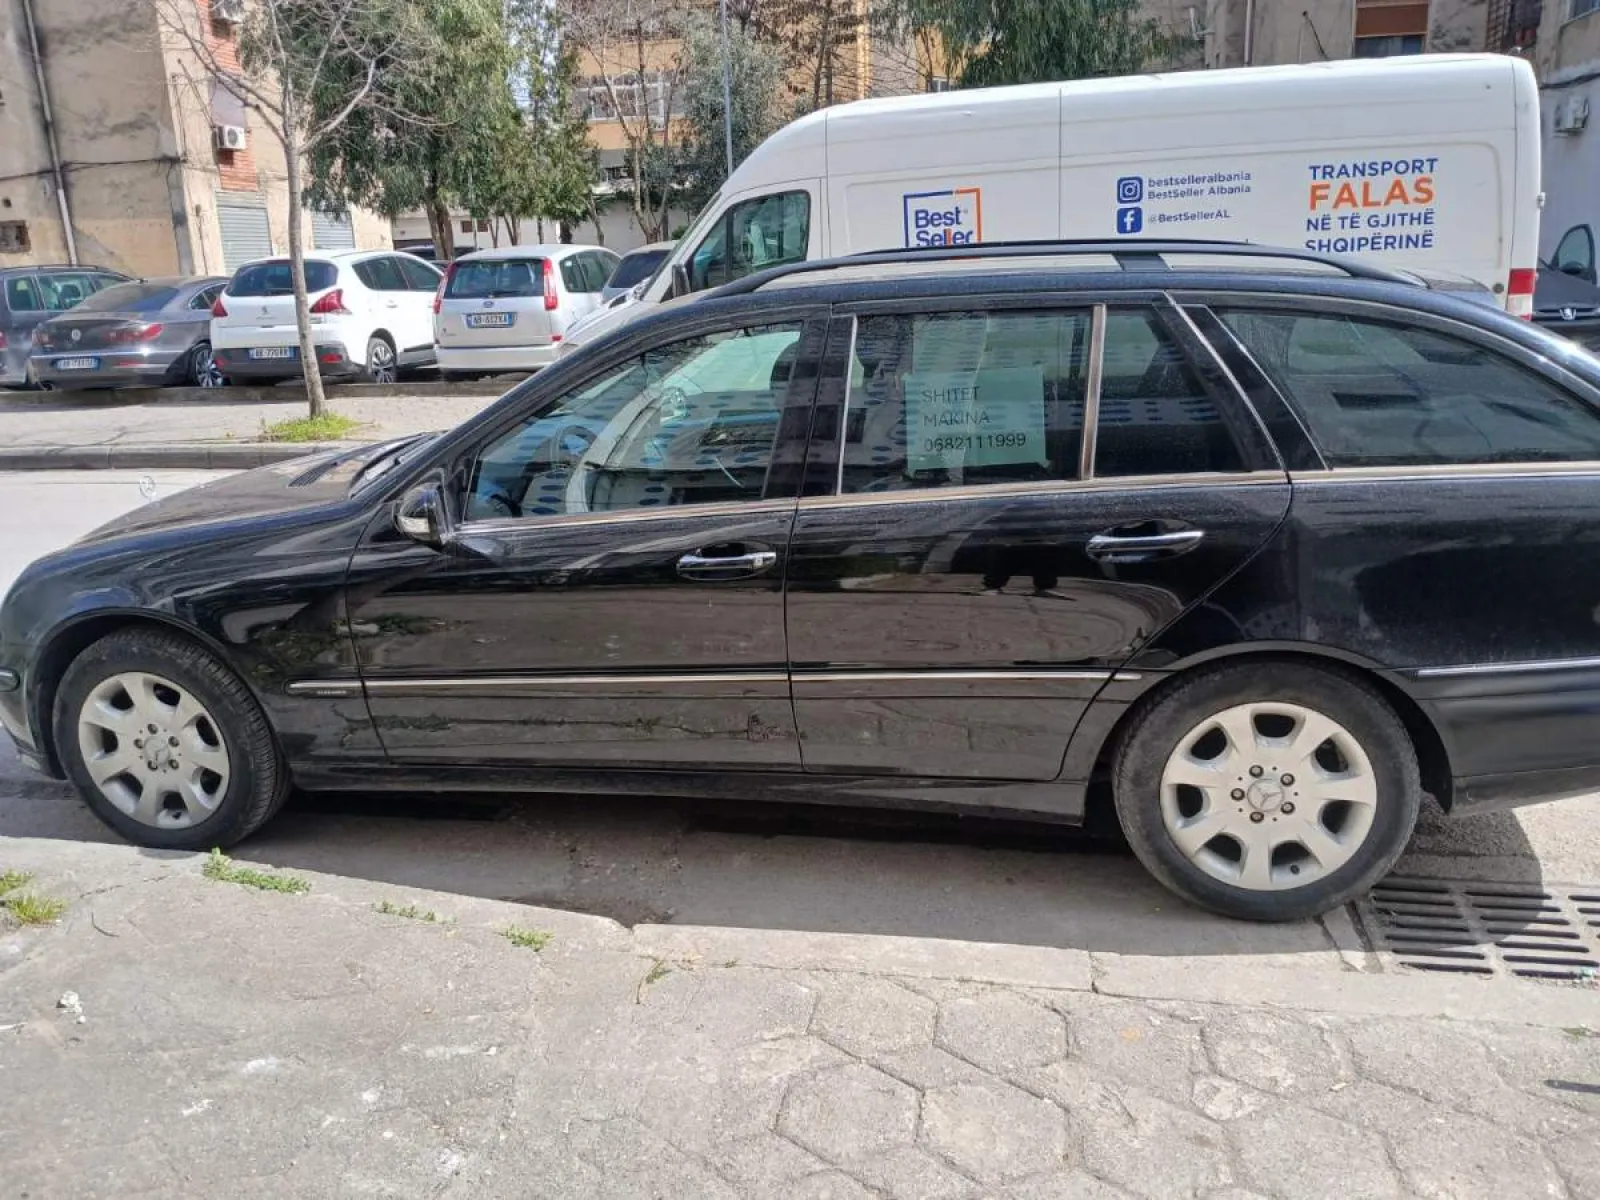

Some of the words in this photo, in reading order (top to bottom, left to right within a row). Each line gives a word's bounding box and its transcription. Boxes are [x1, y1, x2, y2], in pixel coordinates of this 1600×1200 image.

[1308, 158, 1438, 180] TRANSPORT
[1148, 171, 1251, 188] bestselleralbania
[1148, 187, 1204, 200] BestSeller
[1207, 184, 1251, 196] Albania
[1309, 176, 1434, 211] FALAS
[915, 206, 962, 229] Best
[1306, 213, 1332, 232] NË
[1337, 212, 1361, 230] TË
[1367, 208, 1435, 229] GJITHË
[916, 228, 973, 246] Seller
[1305, 230, 1434, 253] SHQIPËRINË
[922, 386, 980, 403] SHITET
[923, 410, 991, 427] MAKINA
[924, 433, 1026, 451] 0682111999
